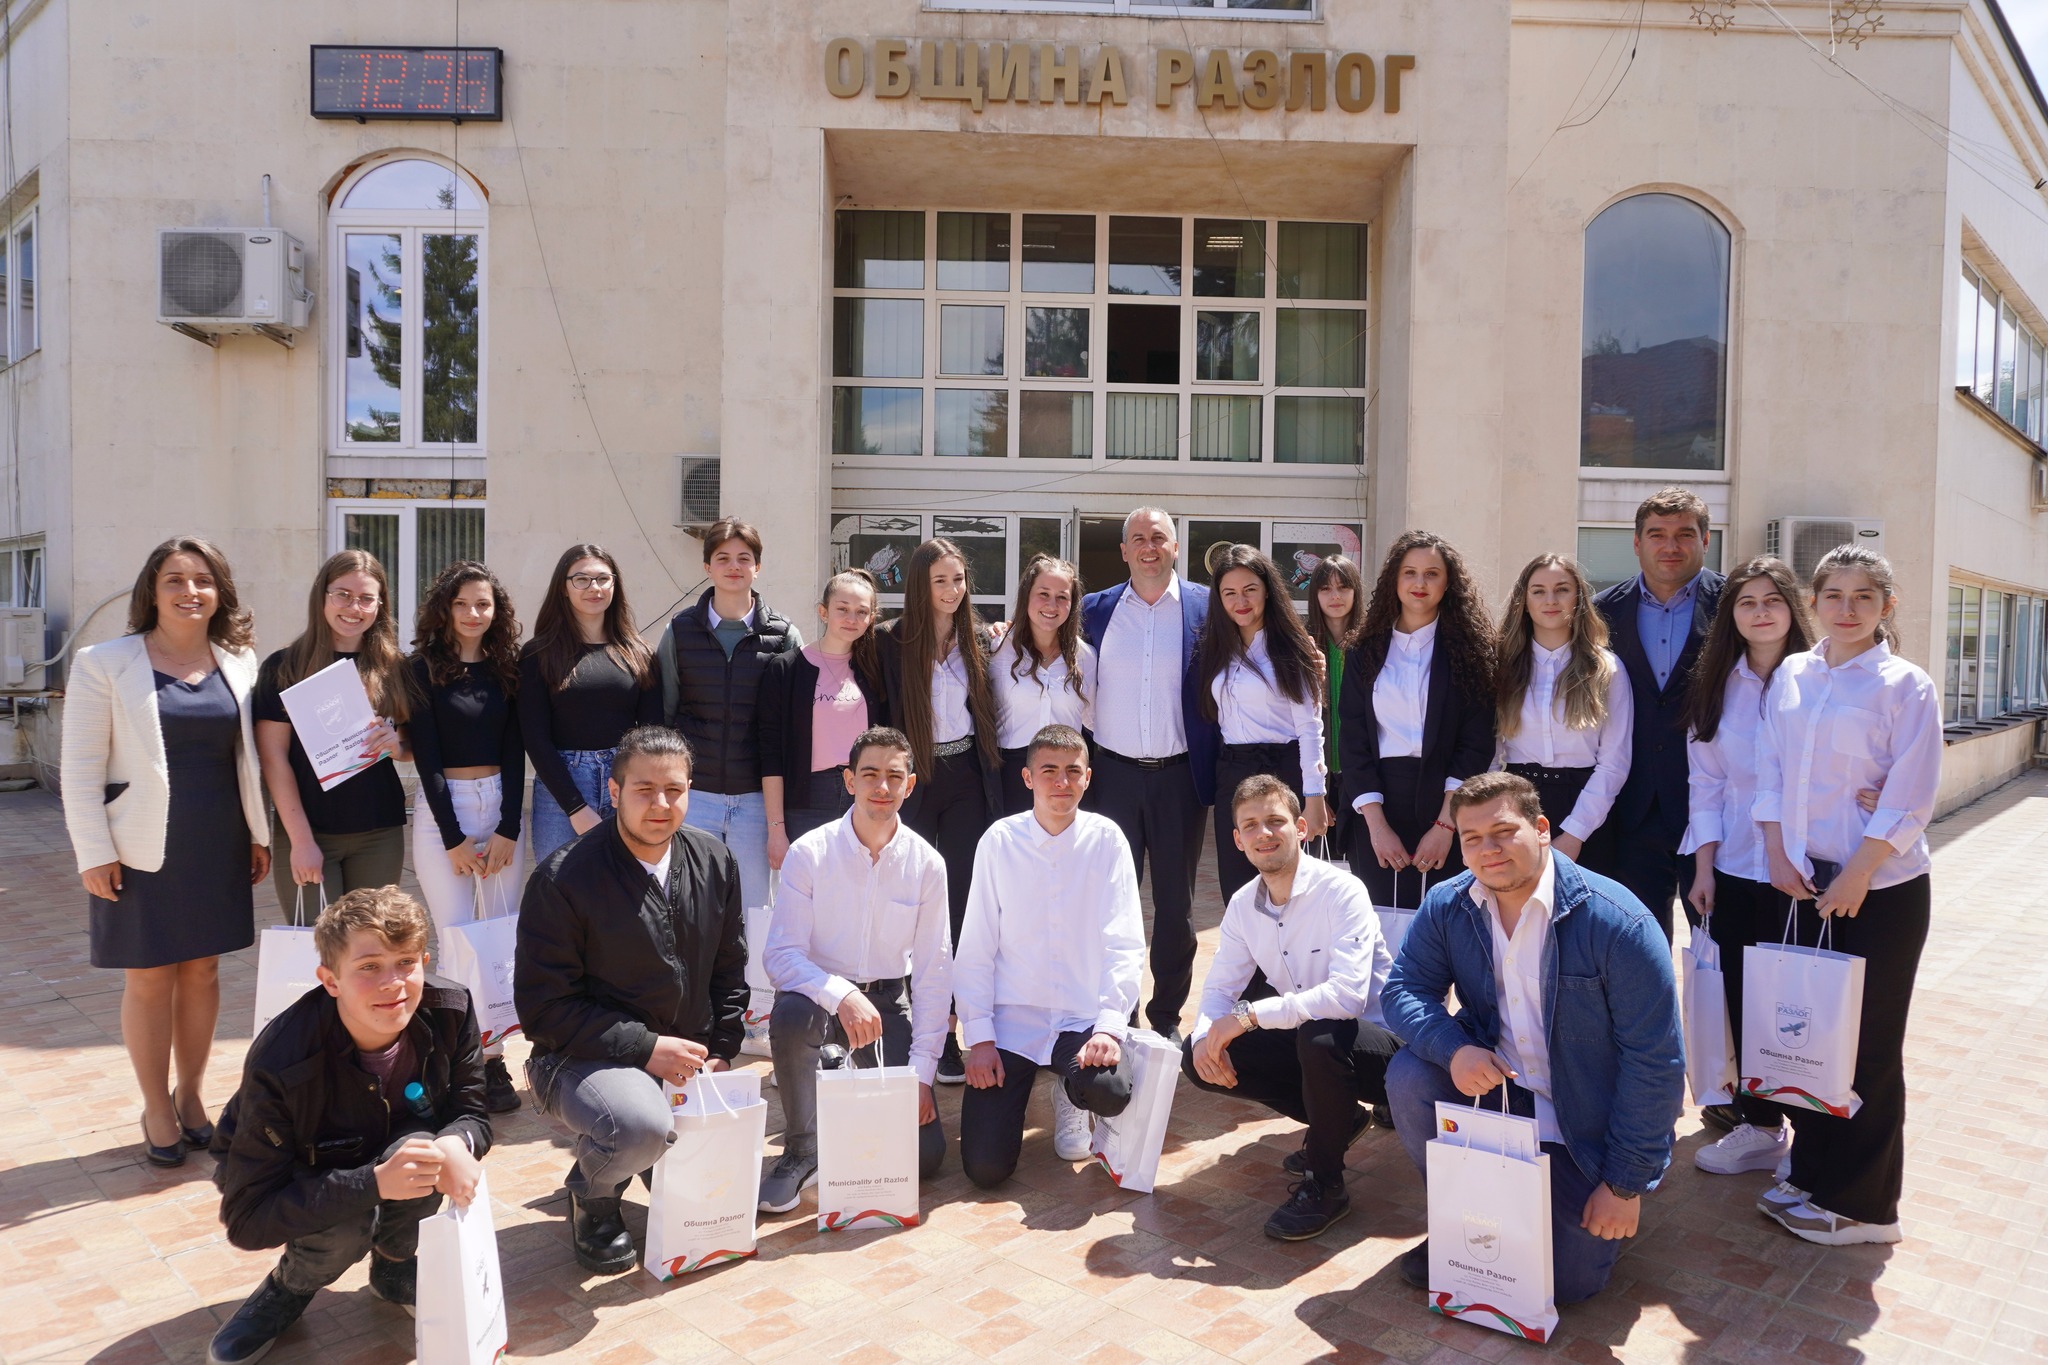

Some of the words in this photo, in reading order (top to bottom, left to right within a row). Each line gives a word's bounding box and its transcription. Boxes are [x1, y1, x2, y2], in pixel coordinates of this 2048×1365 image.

[823, 37, 1128, 113] ОБЩИНА
[1155, 47, 1416, 113] РАЗЛОГ
[1777, 1006, 1811, 1018] РАЗЛОГ
[1795, 1055, 1825, 1067] Разлог
[828, 1179, 873, 1188] Municipality
[874, 1177, 882, 1185] of
[884, 1176, 909, 1184] Razlog
[719, 1212, 746, 1224] Разлог
[1486, 1269, 1517, 1284] Разлог
